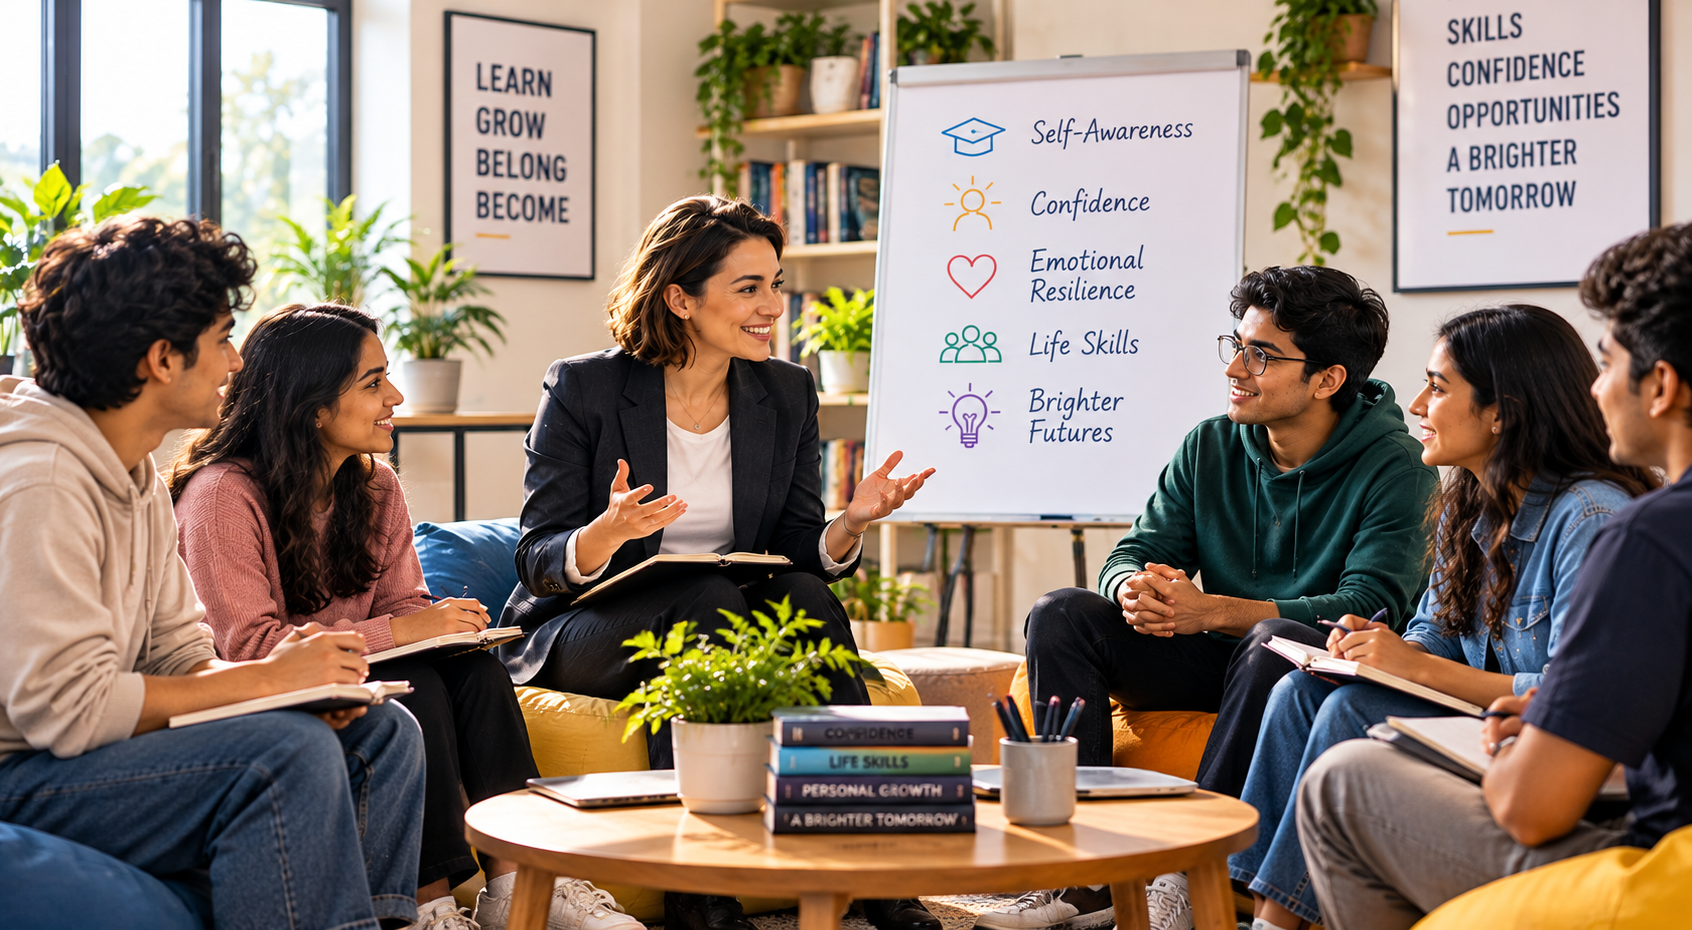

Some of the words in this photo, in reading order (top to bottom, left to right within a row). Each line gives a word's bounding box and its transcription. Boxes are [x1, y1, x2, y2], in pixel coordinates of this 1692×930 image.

[1447, 12, 1523, 45] SKILLS
[476, 62, 553, 98] LEARN
[1447, 50, 1585, 87] CONFIDENCE
[476, 107, 546, 139] GROW
[1447, 91, 1621, 130] OPPORTUNITIES
[1030, 118, 1194, 150] Self-Awareness
[476, 149, 567, 182] BELONG
[1447, 147, 1461, 173] A
[1469, 139, 1577, 171] BRIGHTER
[476, 191, 570, 223] BECOME
[1030, 188, 1151, 221] Confidence
[1447, 181, 1577, 213] TOMORROW
[1030, 244, 1144, 273] Emotional
[1030, 277, 1136, 303] Resilience
[1029, 330, 1071, 362] Life
[1081, 329, 1140, 356] Skills
[1029, 387, 1125, 421] Brighter
[1029, 418, 1114, 444] Futures
[829, 755, 859, 769] LIFE
[863, 755, 909, 769] SKILLS
[802, 783, 876, 798] PERSONAL
[878, 783, 943, 798] GROWTH
[790, 813, 802, 827] A
[804, 812, 874, 827] BRIGHTER
[875, 813, 959, 827] TOMORROW
